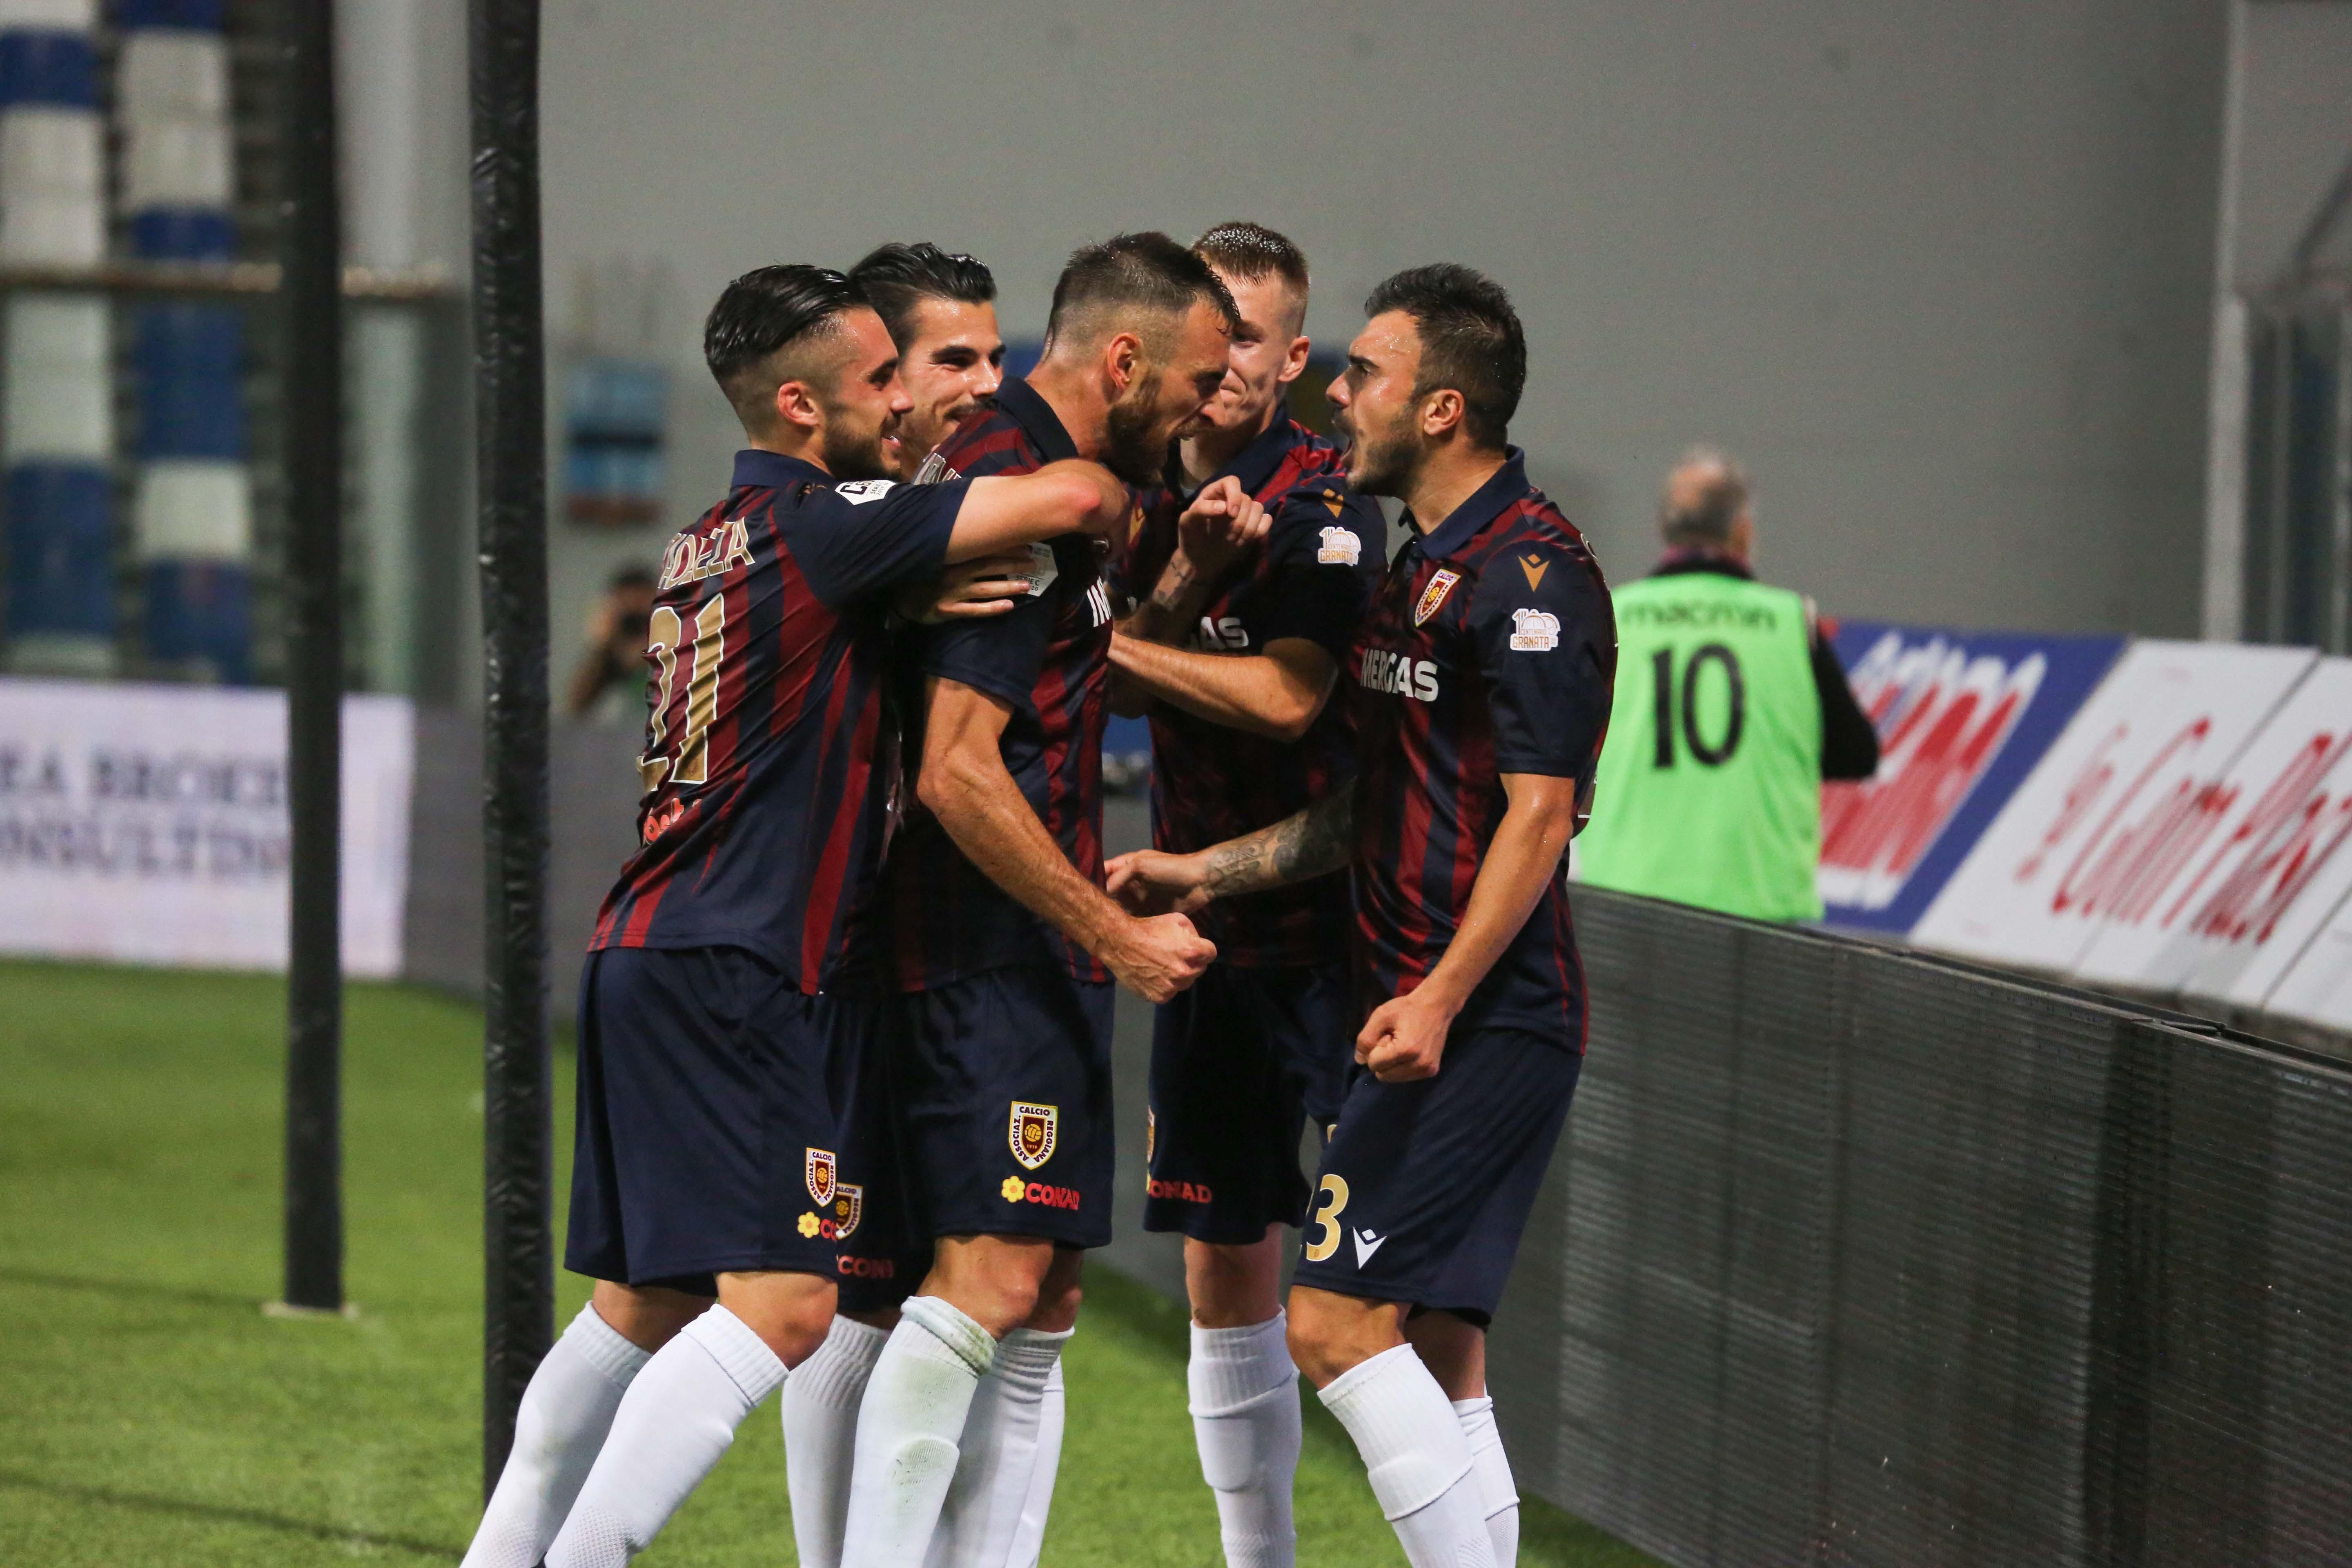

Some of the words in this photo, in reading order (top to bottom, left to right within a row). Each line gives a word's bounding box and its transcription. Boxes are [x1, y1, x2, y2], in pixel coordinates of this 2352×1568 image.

[1513, 636, 1549, 648] GRANATA
[637, 592, 725, 791] 21
[1653, 642, 1744, 769] 10
[1019, 1106, 1050, 1116] CALCIO
[812, 1152, 832, 1161] CALCIO
[1013, 1115, 1029, 1161] ASSOCIAZ.
[1033, 1120, 1054, 1163] REGGIANA
[824, 1165, 834, 1201] REGGIANA
[1025, 1183, 1080, 1210] CONAD
[1307, 1174, 1349, 1262] 3
